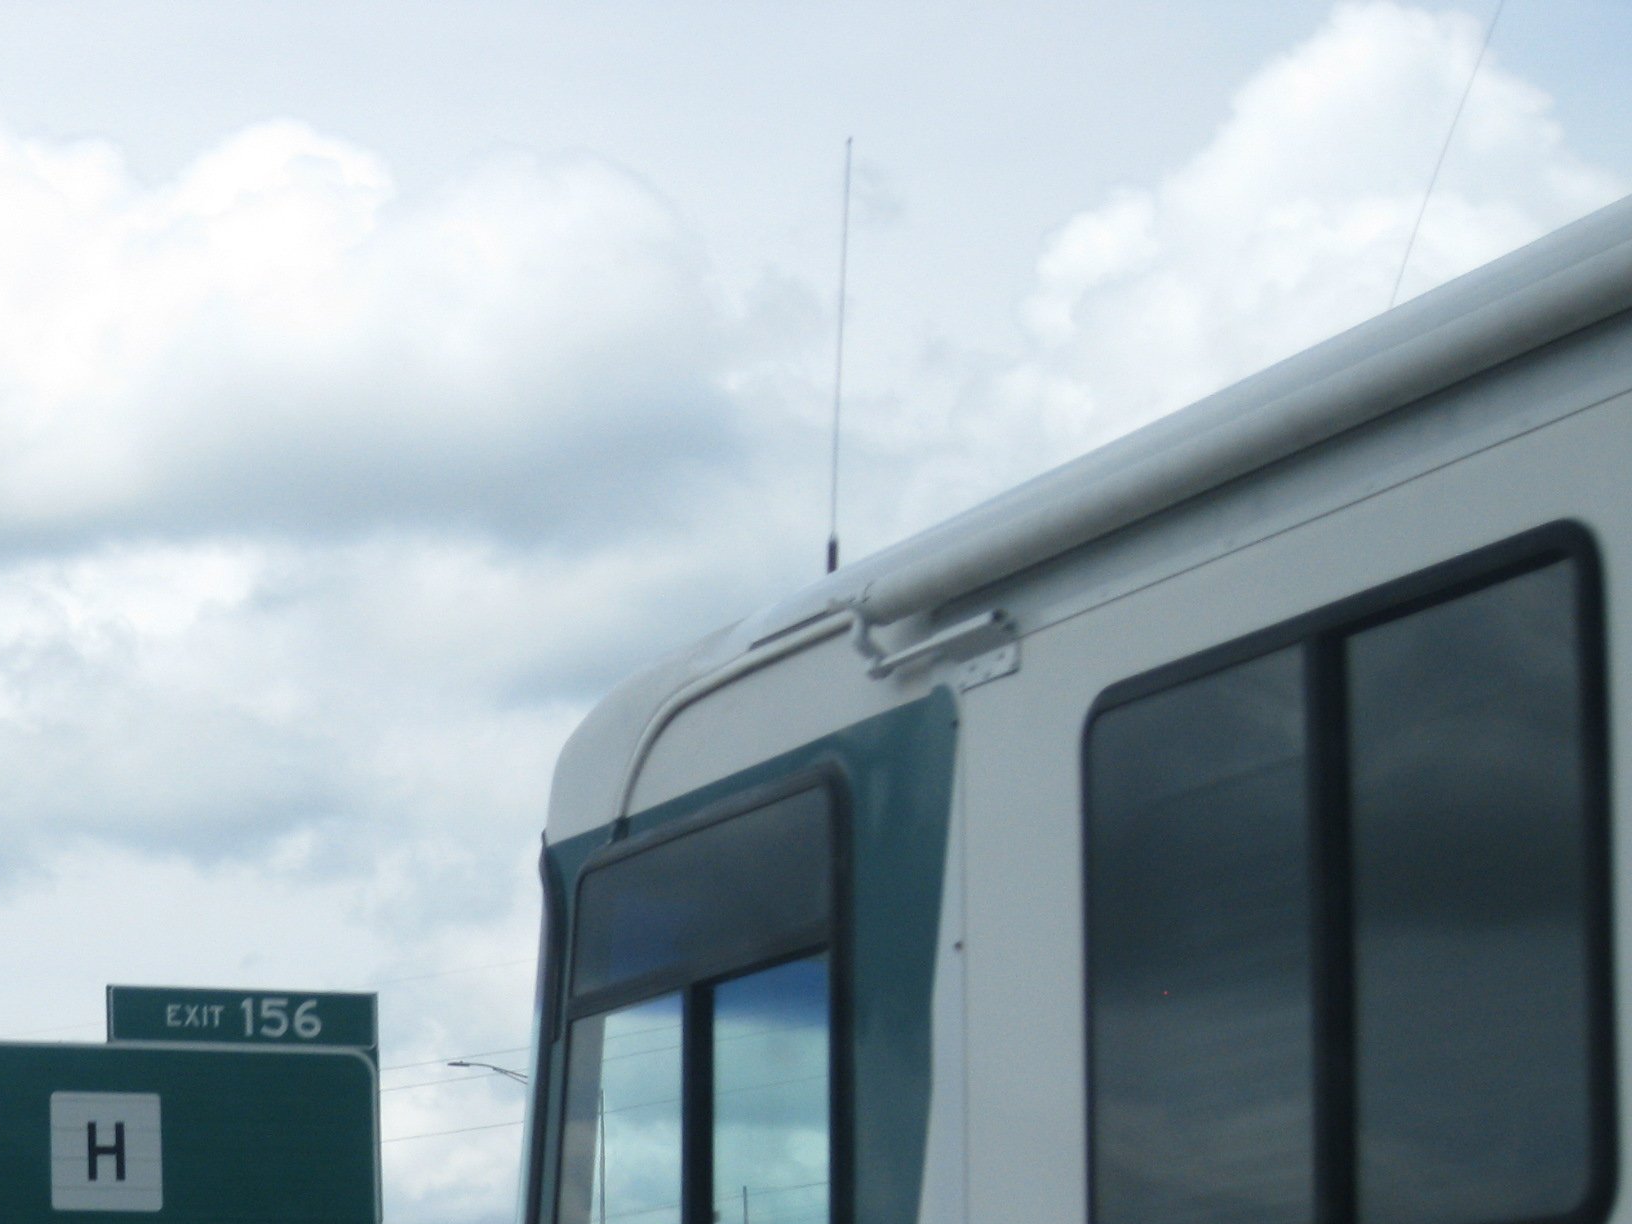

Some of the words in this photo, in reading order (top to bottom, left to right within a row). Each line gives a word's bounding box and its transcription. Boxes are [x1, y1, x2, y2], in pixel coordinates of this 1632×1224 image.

[166, 1004, 223, 1028] EXIT
[241, 998, 322, 1038] 156
[87, 1120, 126, 1182] H
